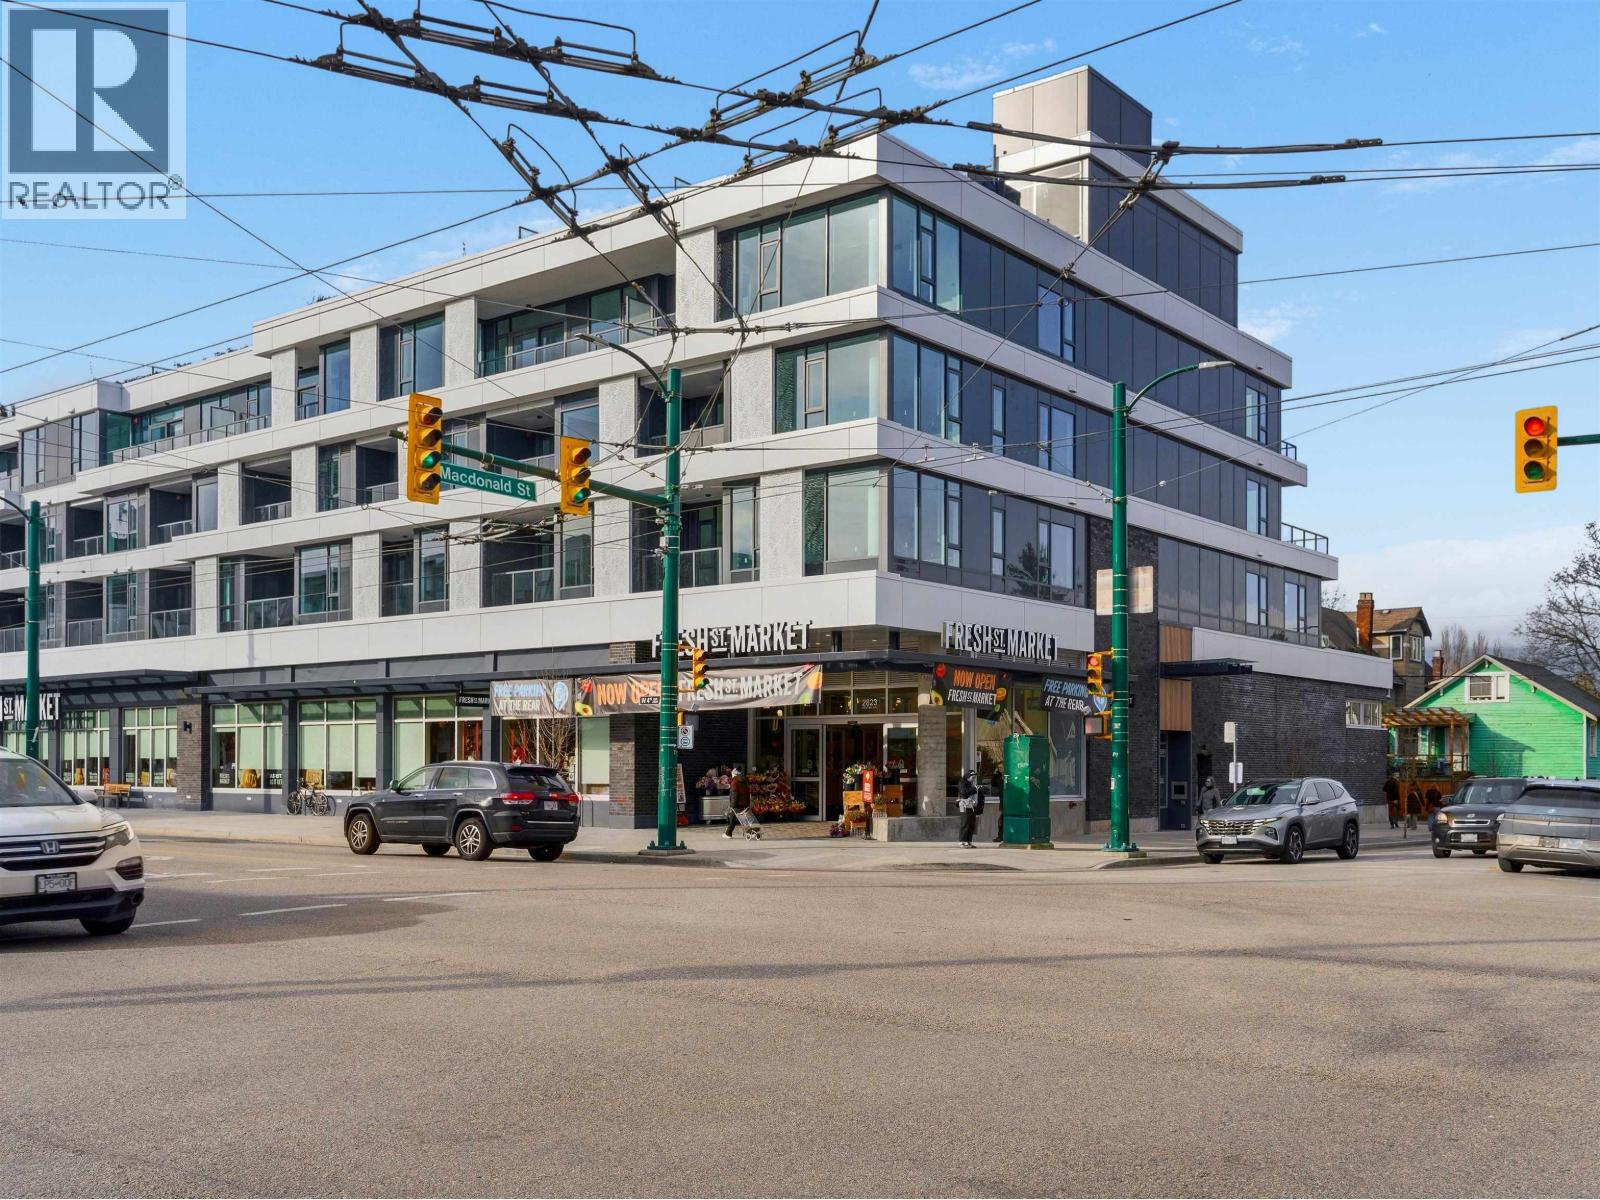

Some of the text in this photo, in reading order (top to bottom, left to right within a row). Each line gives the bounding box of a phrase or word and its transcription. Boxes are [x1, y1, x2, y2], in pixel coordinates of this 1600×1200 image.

[441, 465, 531, 496] Macdonald St
[652, 628, 709, 658] FSH
[729, 623, 811, 654] MARKET
[945, 621, 992, 653] FRESH
[1007, 629, 1059, 661] MARKET
[739, 671, 803, 699] MARKET
[954, 669, 997, 690] NOW OPEN
[1044, 678, 1061, 693] FREE
[596, 682, 628, 705] NOW
[947, 688, 967, 702] FRESH
[972, 691, 997, 705] MARKET
[1045, 695, 1055, 707] AT
[1055, 696, 1067, 709] THE
[15, 693, 60, 721] MKET
